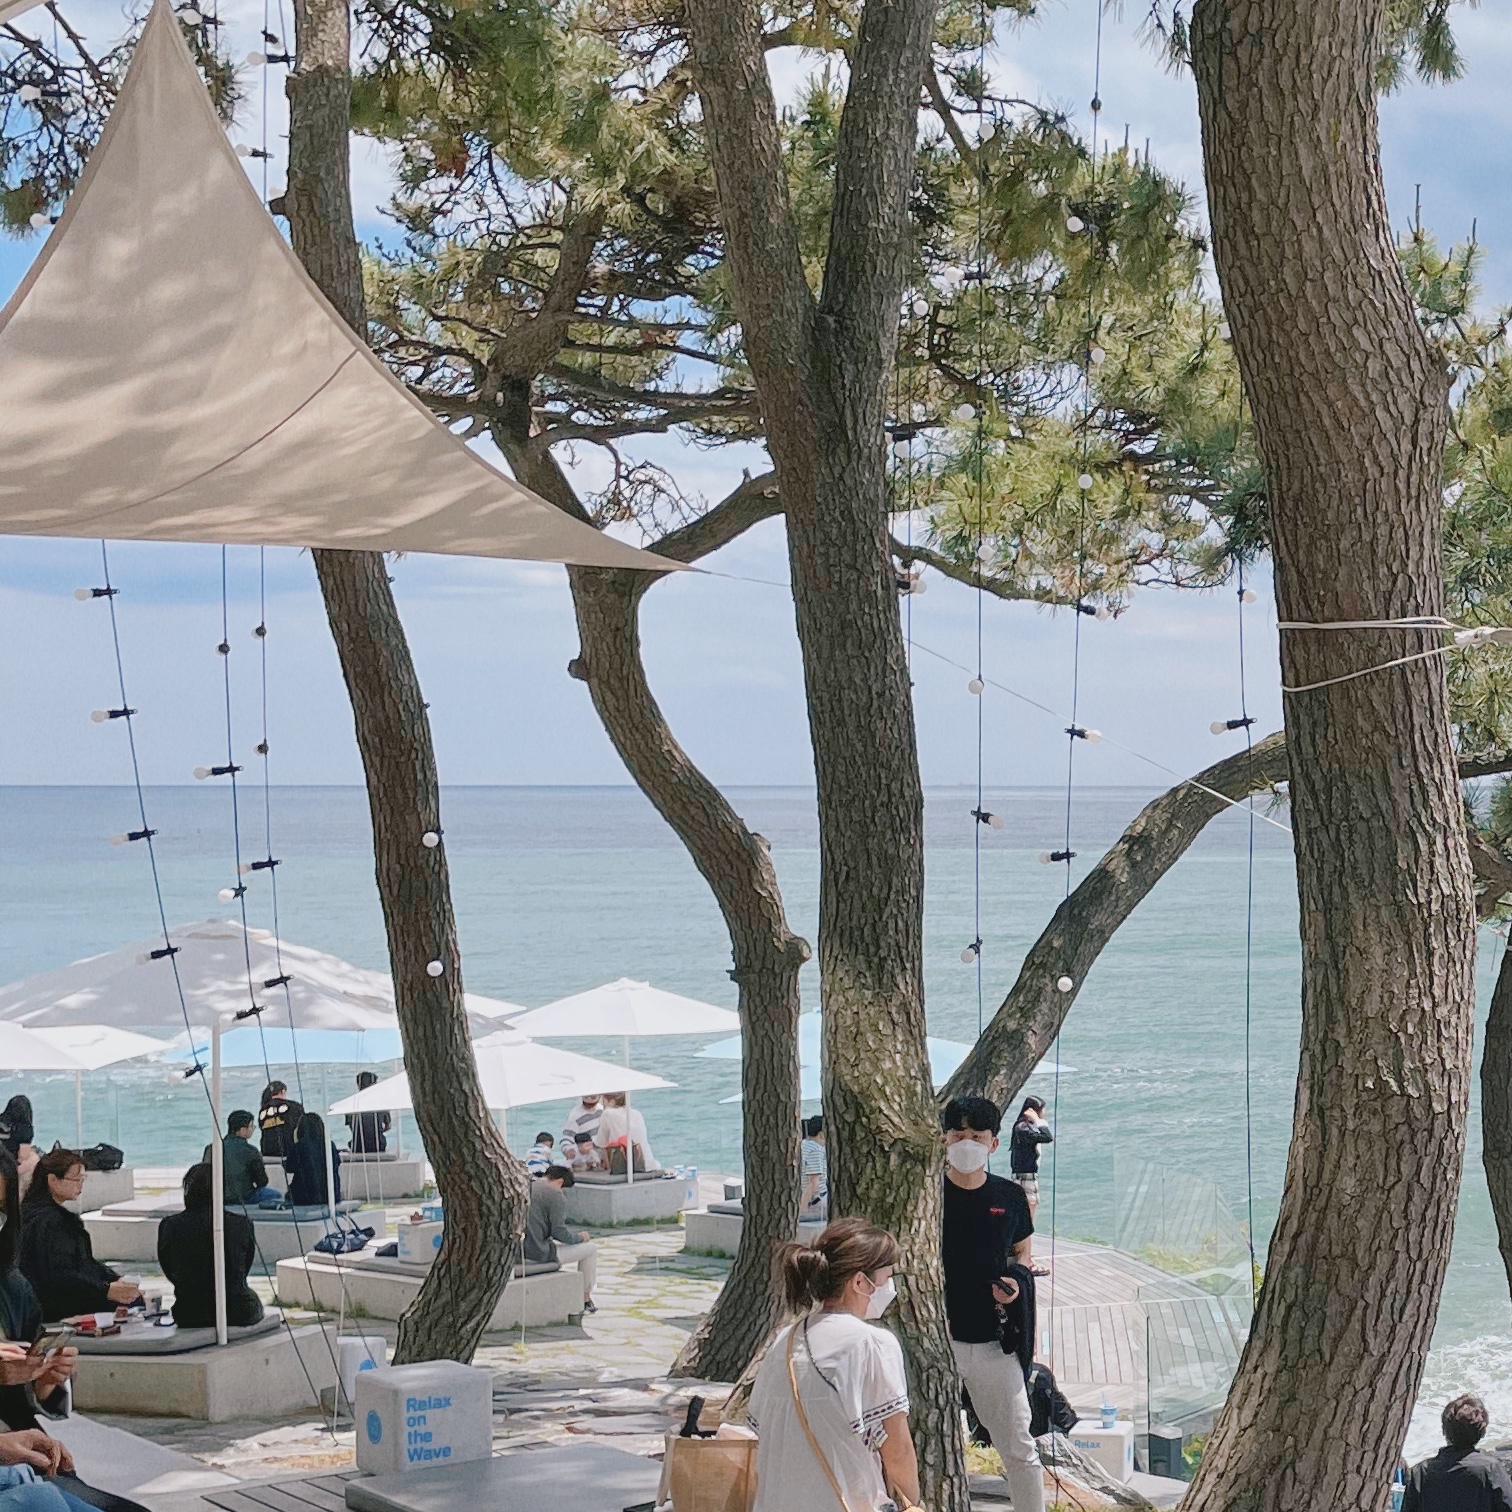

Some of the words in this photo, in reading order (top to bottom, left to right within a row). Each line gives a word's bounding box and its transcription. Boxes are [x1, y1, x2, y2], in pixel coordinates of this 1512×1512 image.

[406, 1396, 451, 1412] Relax
[406, 1415, 427, 1428] on
[407, 1430, 432, 1445] the
[1075, 1440, 1100, 1448] Relax
[407, 1446, 451, 1462] Wave
